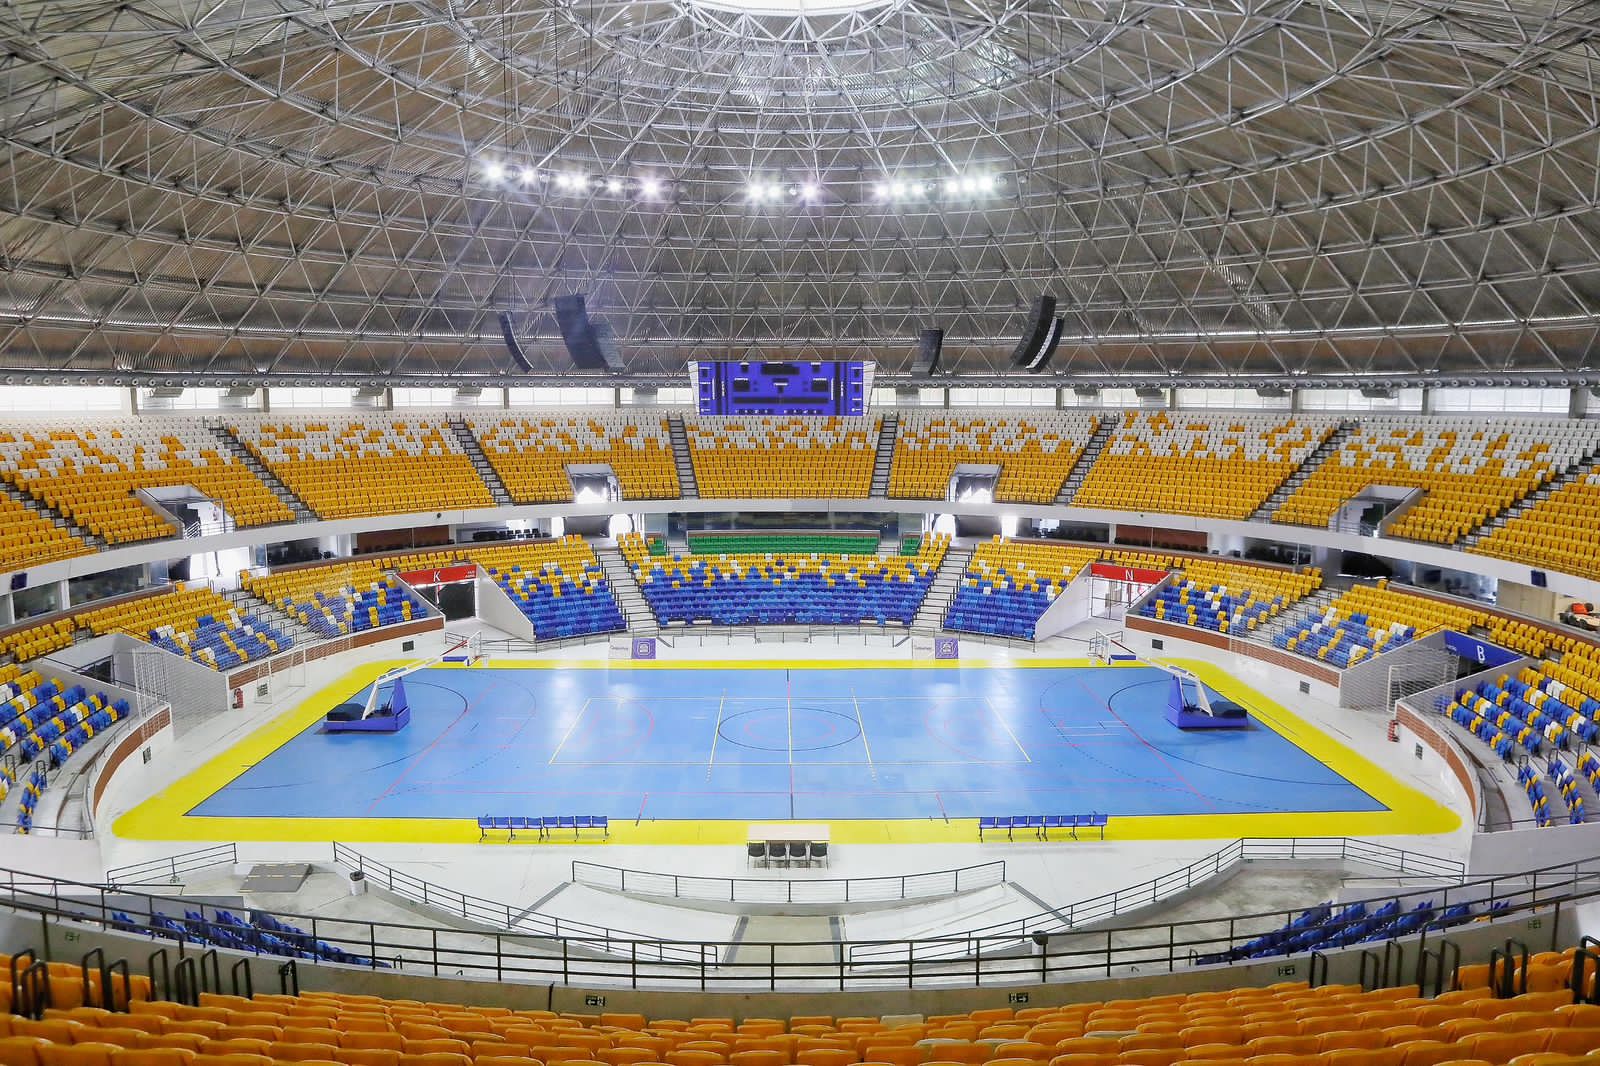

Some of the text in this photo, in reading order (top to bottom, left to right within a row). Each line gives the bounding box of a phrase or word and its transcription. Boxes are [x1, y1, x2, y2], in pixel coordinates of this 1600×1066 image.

[433, 570, 441, 582] K
[1125, 569, 1134, 581] N
[1476, 645, 1485, 662] B
